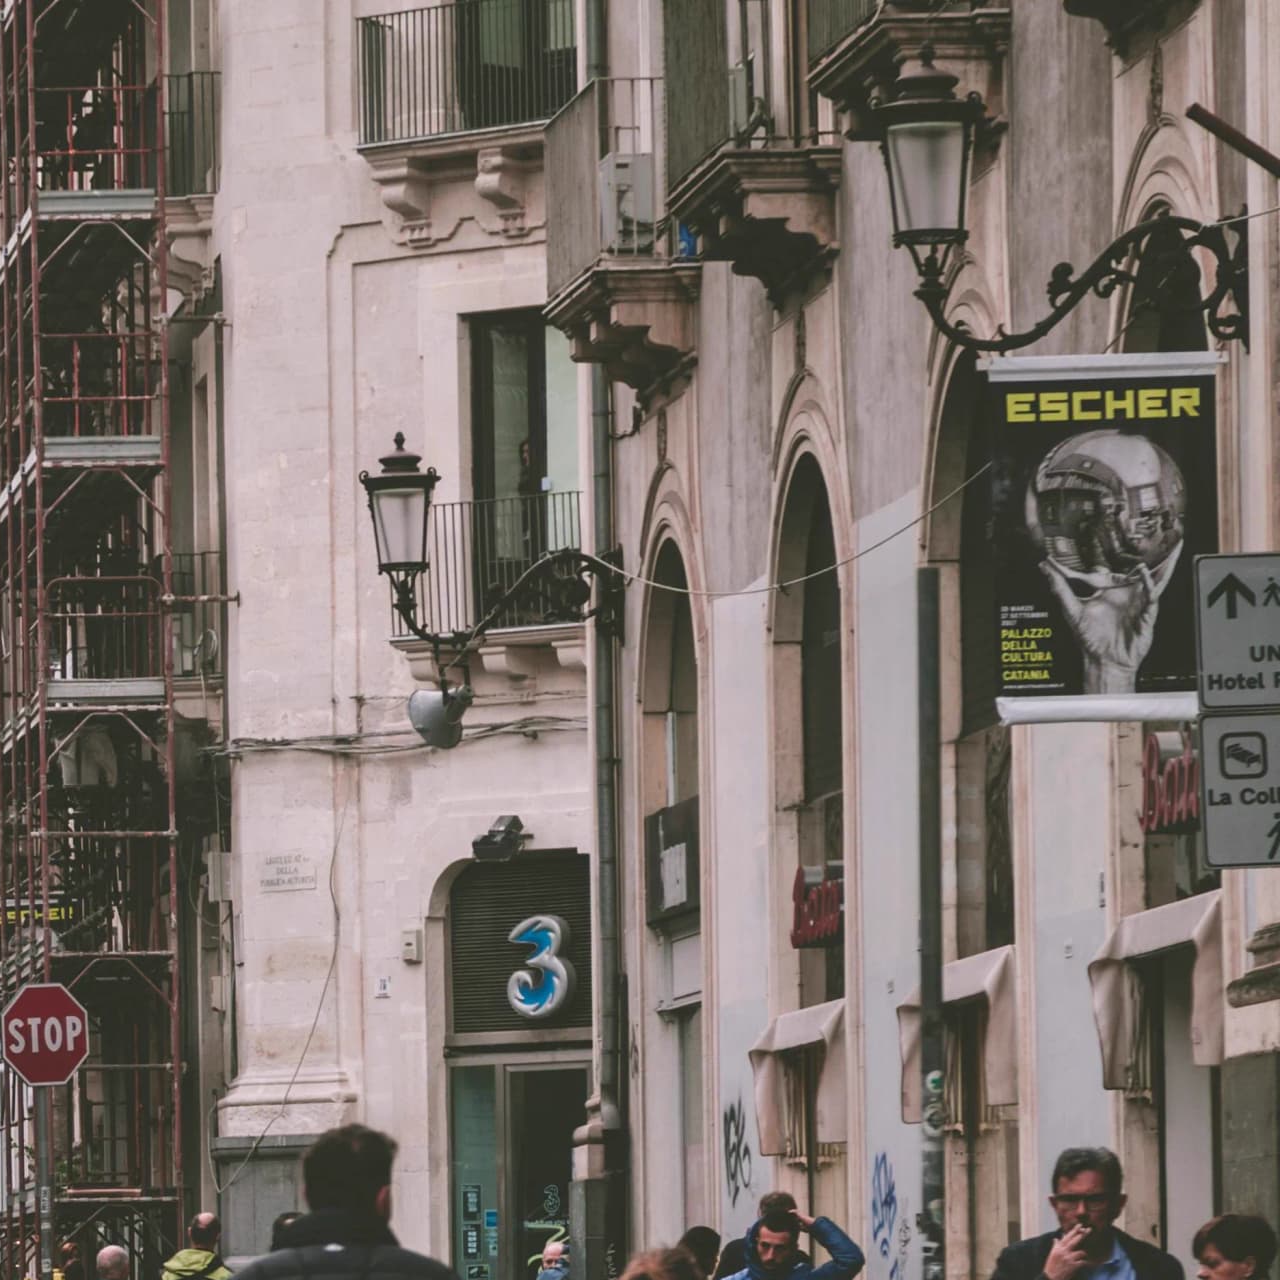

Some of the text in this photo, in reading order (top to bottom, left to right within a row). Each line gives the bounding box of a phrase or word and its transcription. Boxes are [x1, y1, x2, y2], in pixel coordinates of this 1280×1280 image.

[1006, 387, 1200, 422] ESCHER
[1001, 628, 1052, 639] PALAZZO
[1001, 641, 1038, 651] DELLA
[1001, 651, 1053, 662] CULTURA
[1002, 670, 1050, 680] CATANIA
[1207, 672, 1265, 691] Hotel
[1208, 789, 1232, 807] La
[507, 914, 573, 1016] 3
[8, 1015, 82, 1054] STOP
